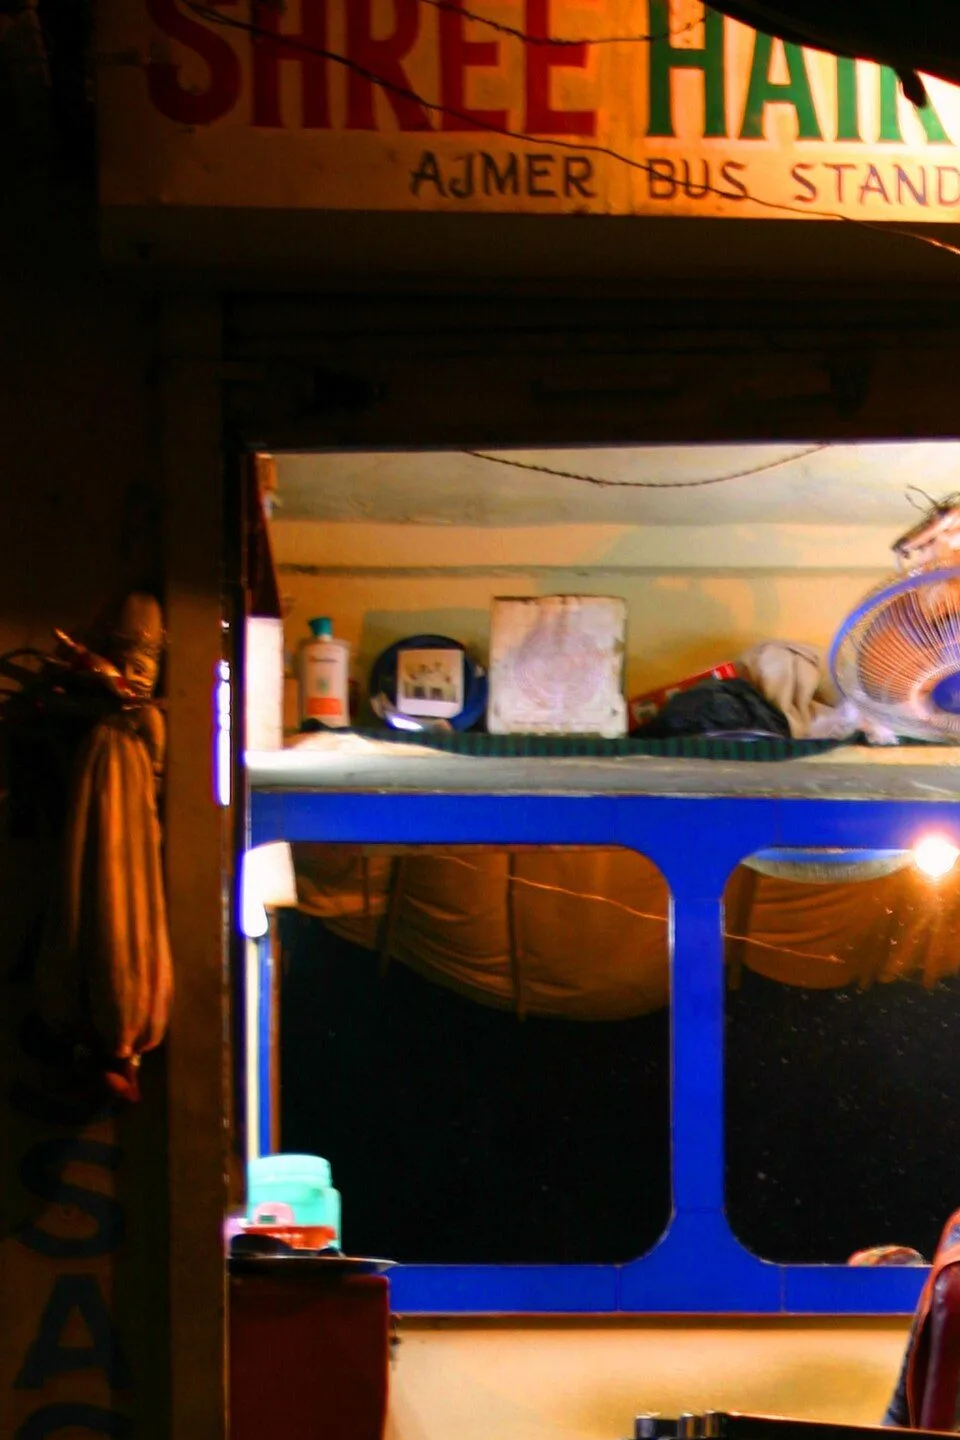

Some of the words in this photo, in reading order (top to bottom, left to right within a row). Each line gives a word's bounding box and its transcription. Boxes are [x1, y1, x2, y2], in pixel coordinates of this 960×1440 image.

[145, 0, 598, 136] SHREE
[409, 152, 597, 200] AJMER
[646, 157, 748, 201] BUS
